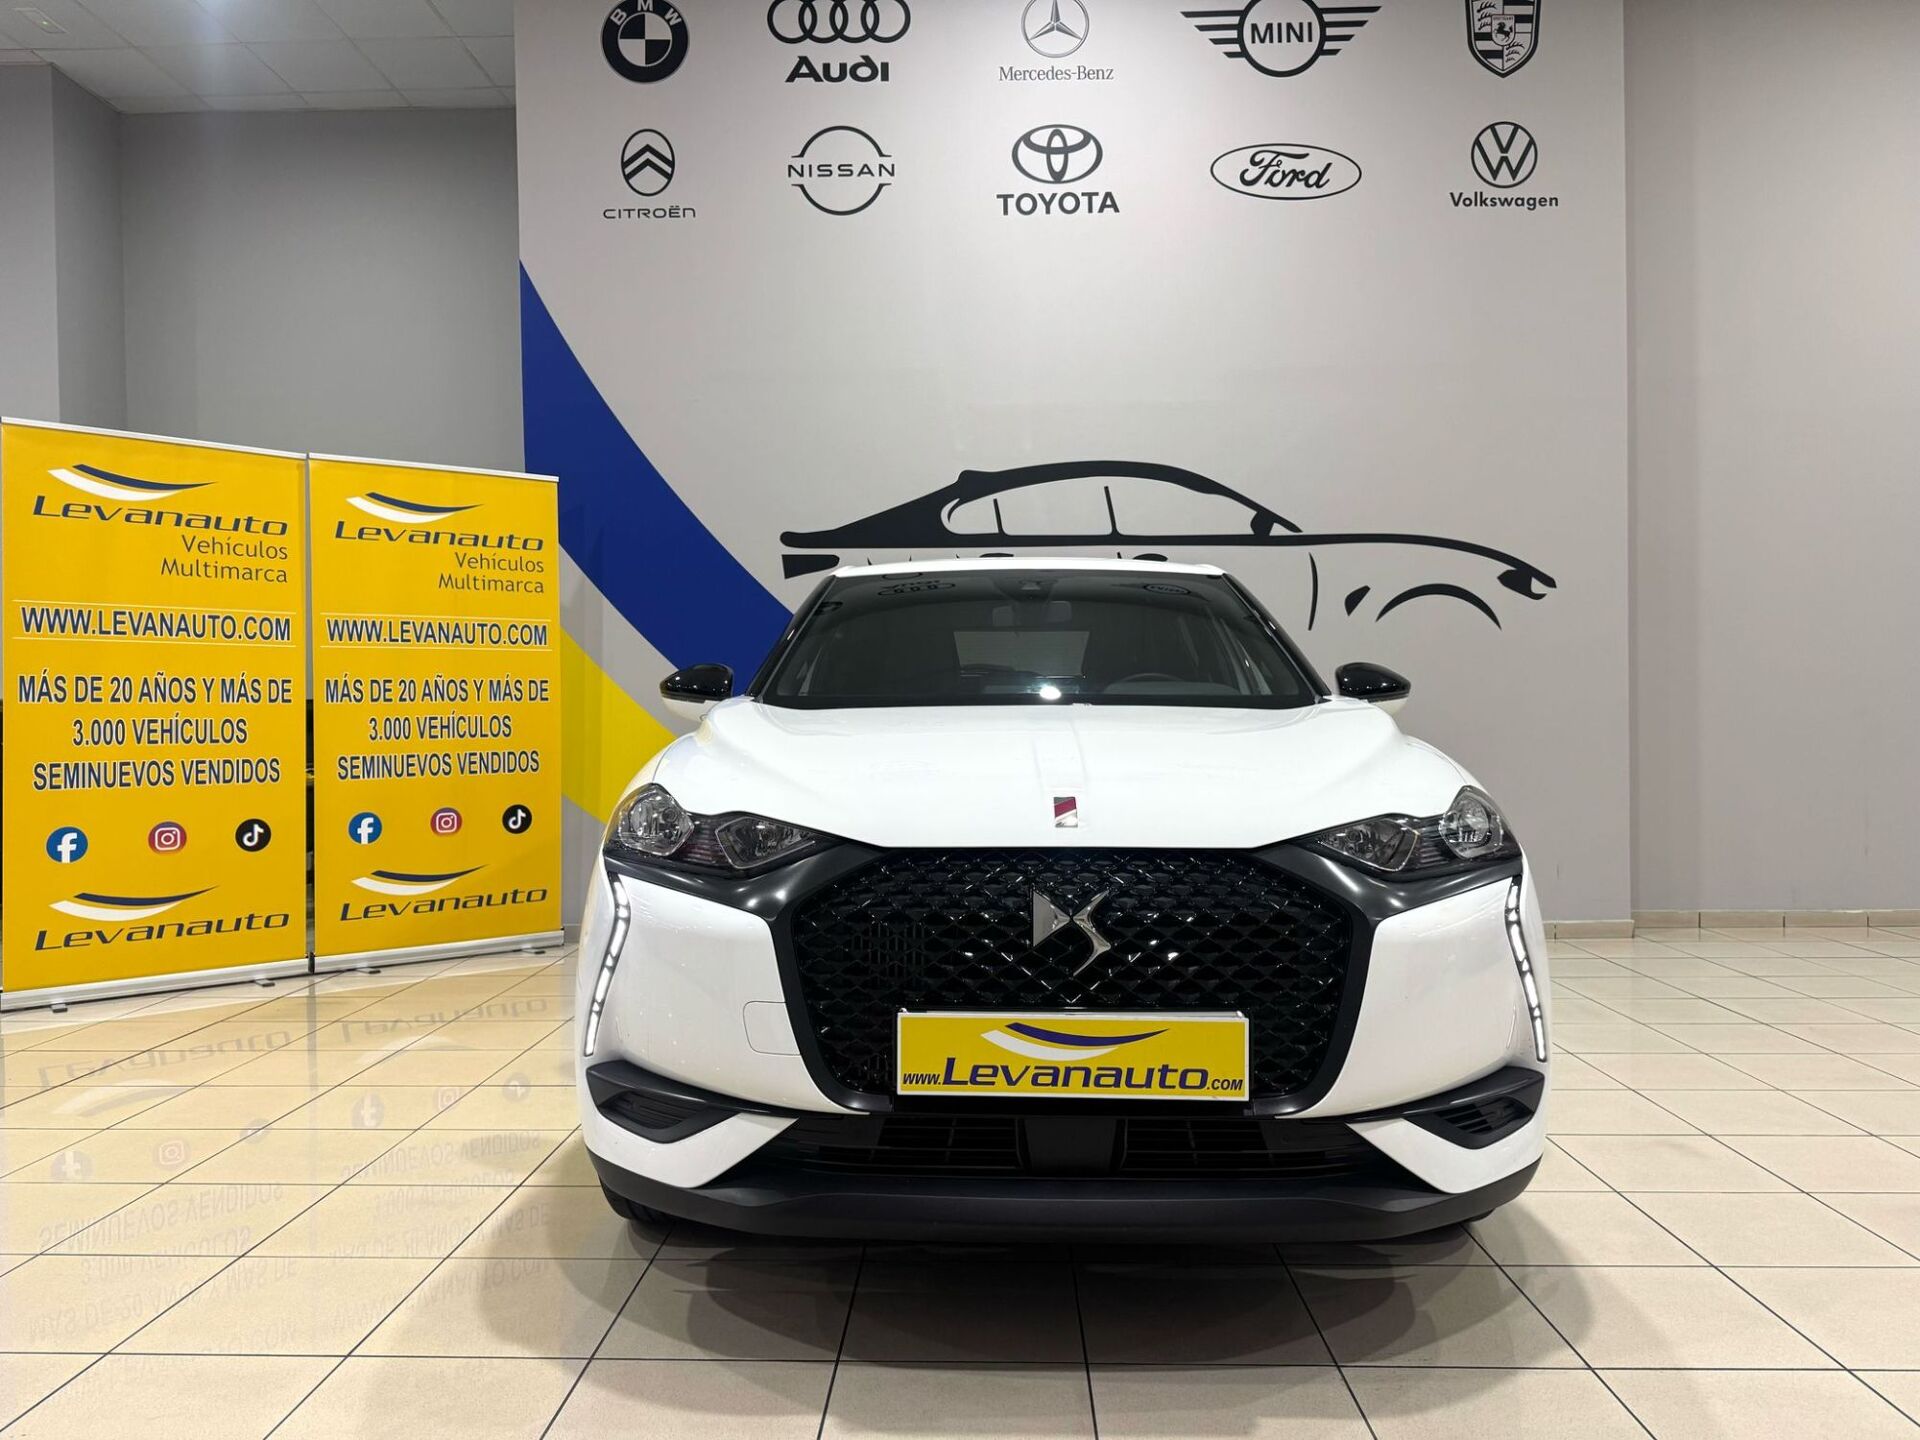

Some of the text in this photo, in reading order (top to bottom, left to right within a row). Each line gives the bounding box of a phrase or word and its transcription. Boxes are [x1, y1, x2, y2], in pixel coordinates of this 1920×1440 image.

[609, 0, 682, 26] BMW
[1250, 21, 1314, 44] MINI
[785, 56, 890, 83] Audi
[999, 65, 1114, 82] Mercedes-Benz
[787, 163, 895, 178] NISSAN
[1239, 149, 1333, 190] Ford
[996, 192, 1120, 216] TOYOTA
[1449, 191, 1559, 211] Volkswagen
[33, 495, 289, 537] Levanauto
[181, 534, 288, 560] Vehículos
[335, 521, 544, 551] Levanauto
[161, 557, 288, 583] Multimarca
[454, 552, 544, 573] Vehículos
[438, 573, 544, 593] Multimarca
[21, 606, 291, 641] WWW.LEVANAUTO.COM
[326, 618, 547, 646] WWW.LEVANAUTO.COM
[18, 668, 292, 704] MÁS DE 20 AÑOS Y MÁS DE
[325, 674, 549, 703] MÁS DE 20 AÑOS Y MÁS DE
[72, 712, 248, 746] 3.000 VEHÍCULOS
[369, 711, 512, 740] 3.000 VEHÍCULOS
[33, 757, 281, 790] SEMINUEVOS VENDIDOS
[337, 750, 540, 780] SEMINUEVOS VENDIDOS
[339, 888, 548, 921] Levanauto
[34, 912, 290, 951] Levanauto
